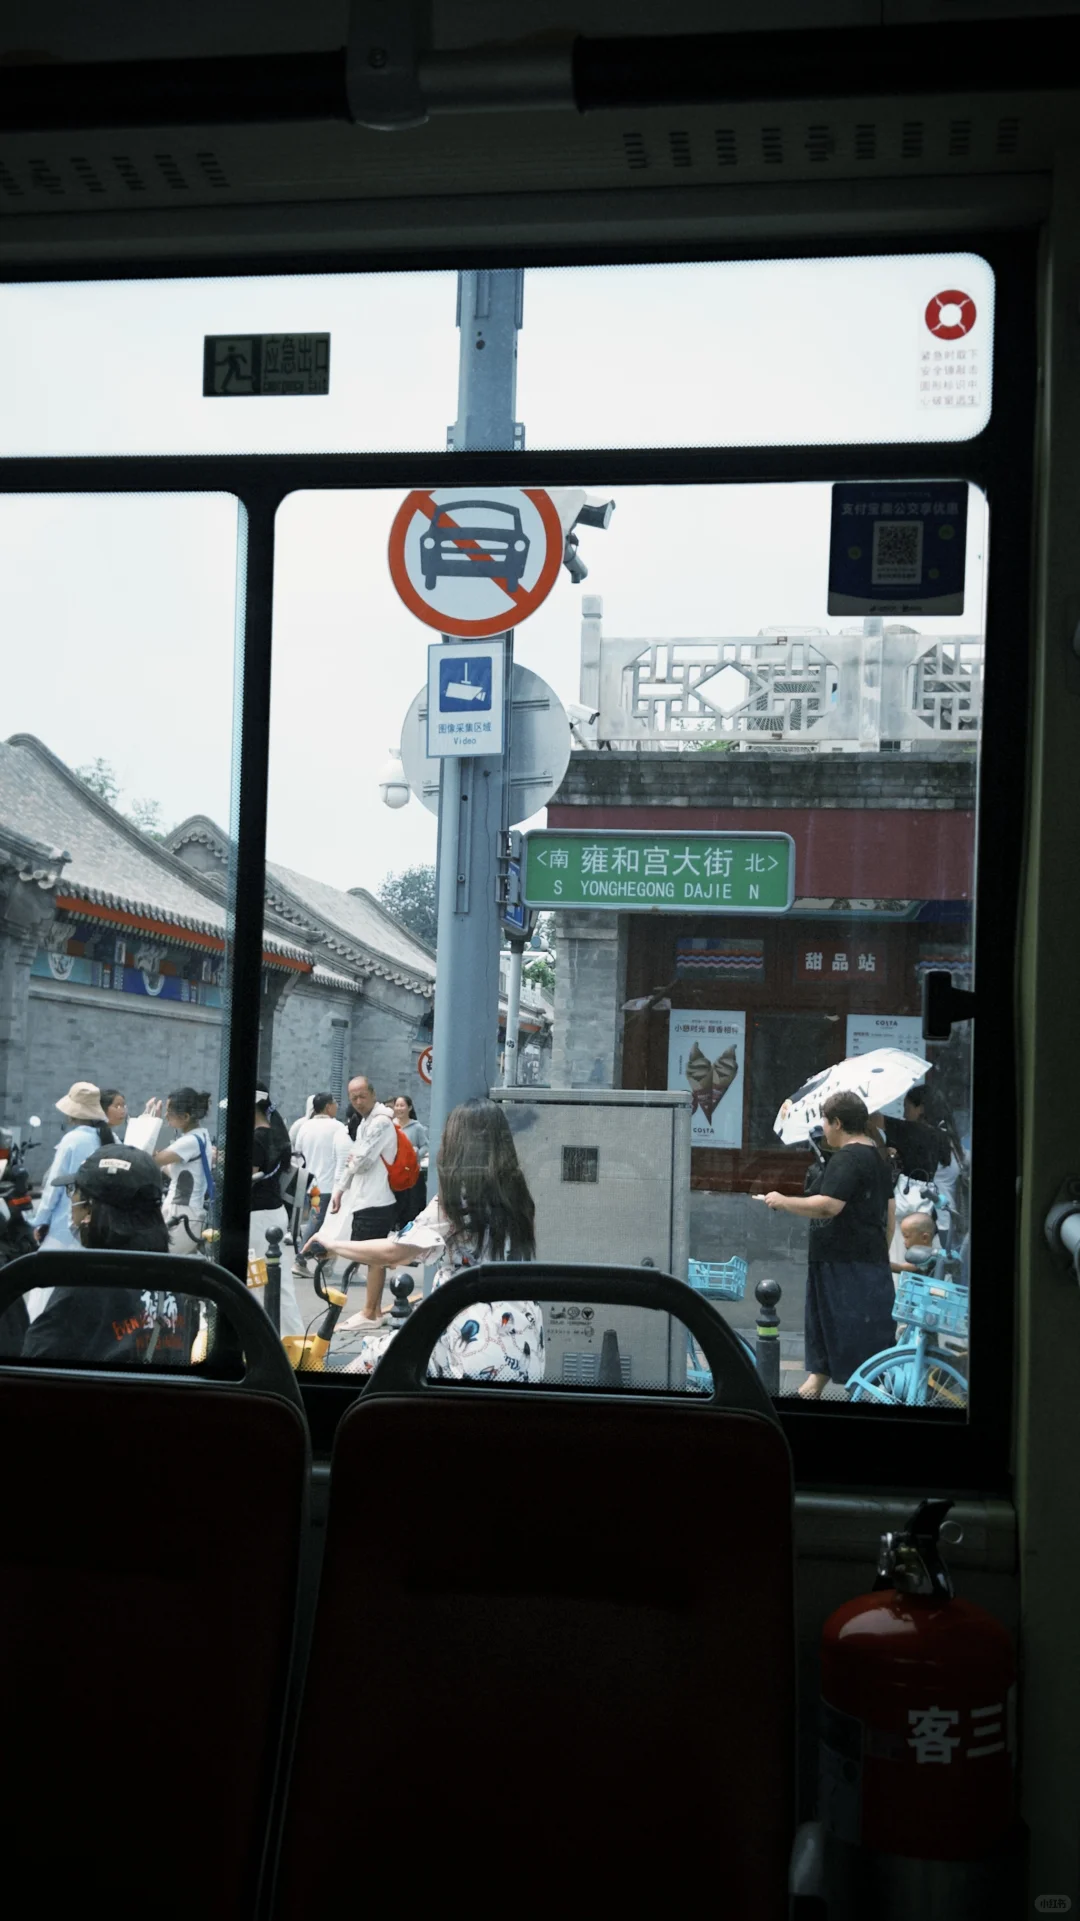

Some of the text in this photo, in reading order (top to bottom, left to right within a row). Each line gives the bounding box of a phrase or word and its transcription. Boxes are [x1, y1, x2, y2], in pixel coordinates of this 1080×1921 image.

[264, 335, 328, 374] 应急出口
[438, 720, 492, 734] 图像采集区域
[453, 737, 477, 745] Video
[549, 844, 766, 877] 南 雍和宫大街 北
[553, 879, 760, 900] S YONGHEGONG DAJIE N
[805, 952, 876, 972] 甜品站
